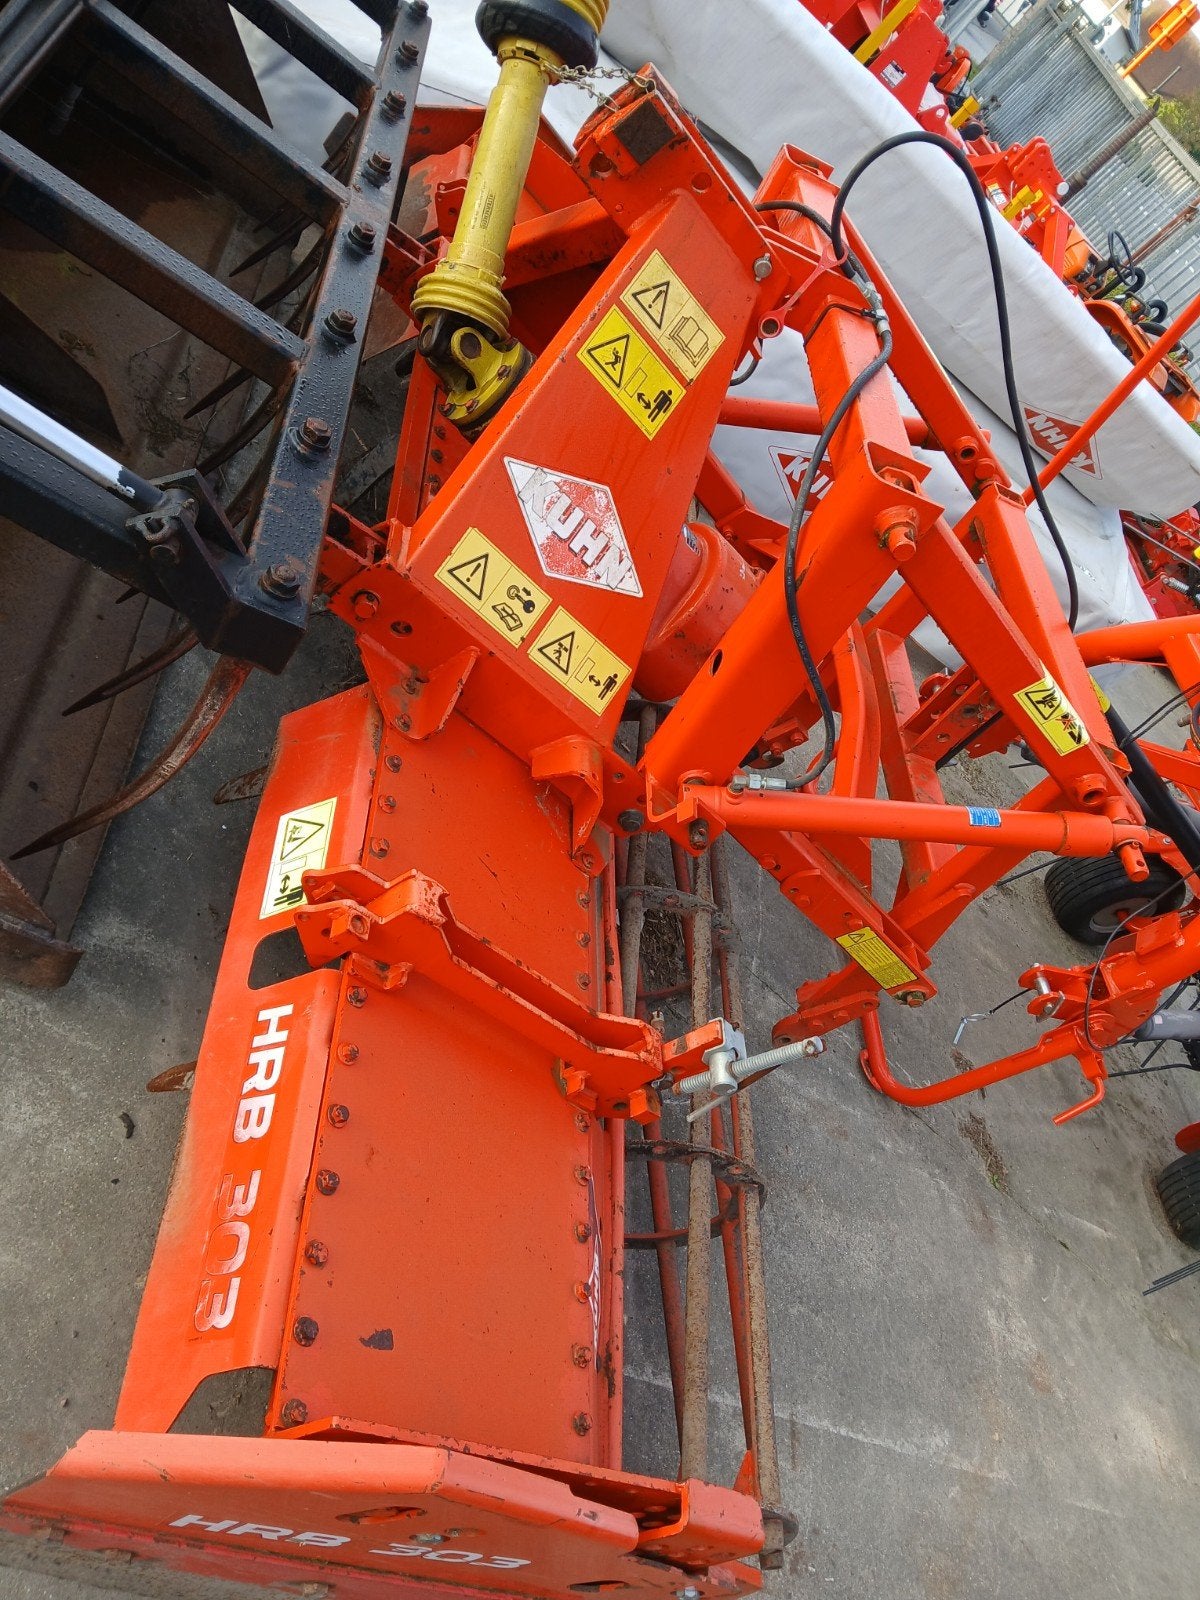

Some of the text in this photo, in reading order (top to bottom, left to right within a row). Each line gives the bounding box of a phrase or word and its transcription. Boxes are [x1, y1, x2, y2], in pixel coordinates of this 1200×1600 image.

[1026, 413, 1094, 468] KHN
[518, 467, 633, 590] KUHN
[194, 1004, 294, 1332] HRB 303
[169, 1514, 532, 1569] HRB 303
